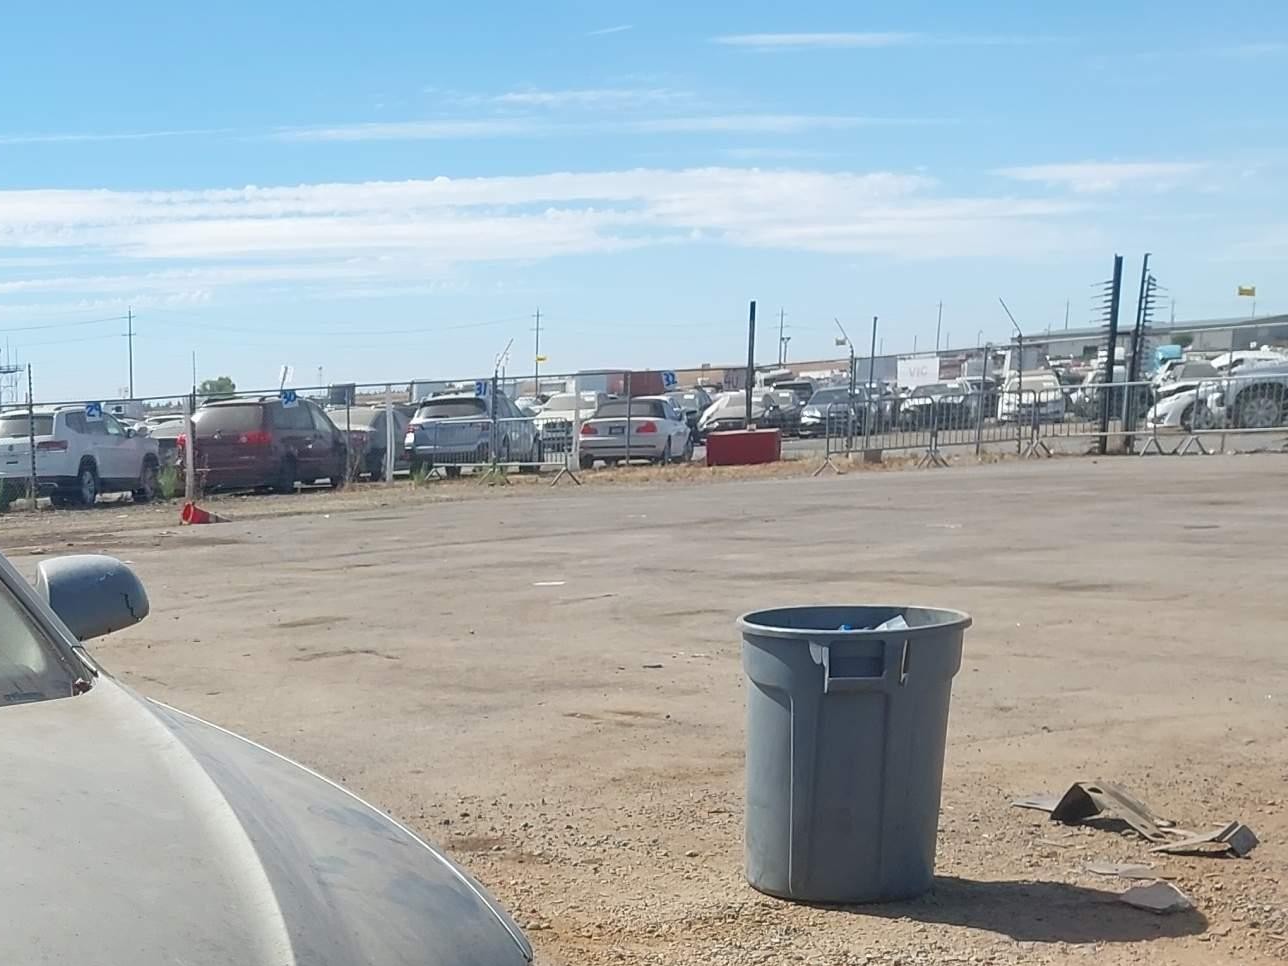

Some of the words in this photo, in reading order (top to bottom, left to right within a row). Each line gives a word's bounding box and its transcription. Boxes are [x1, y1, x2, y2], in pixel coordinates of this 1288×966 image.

[663, 372, 678, 386] 32
[475, 381, 488, 396] 31
[283, 391, 297, 404] 30
